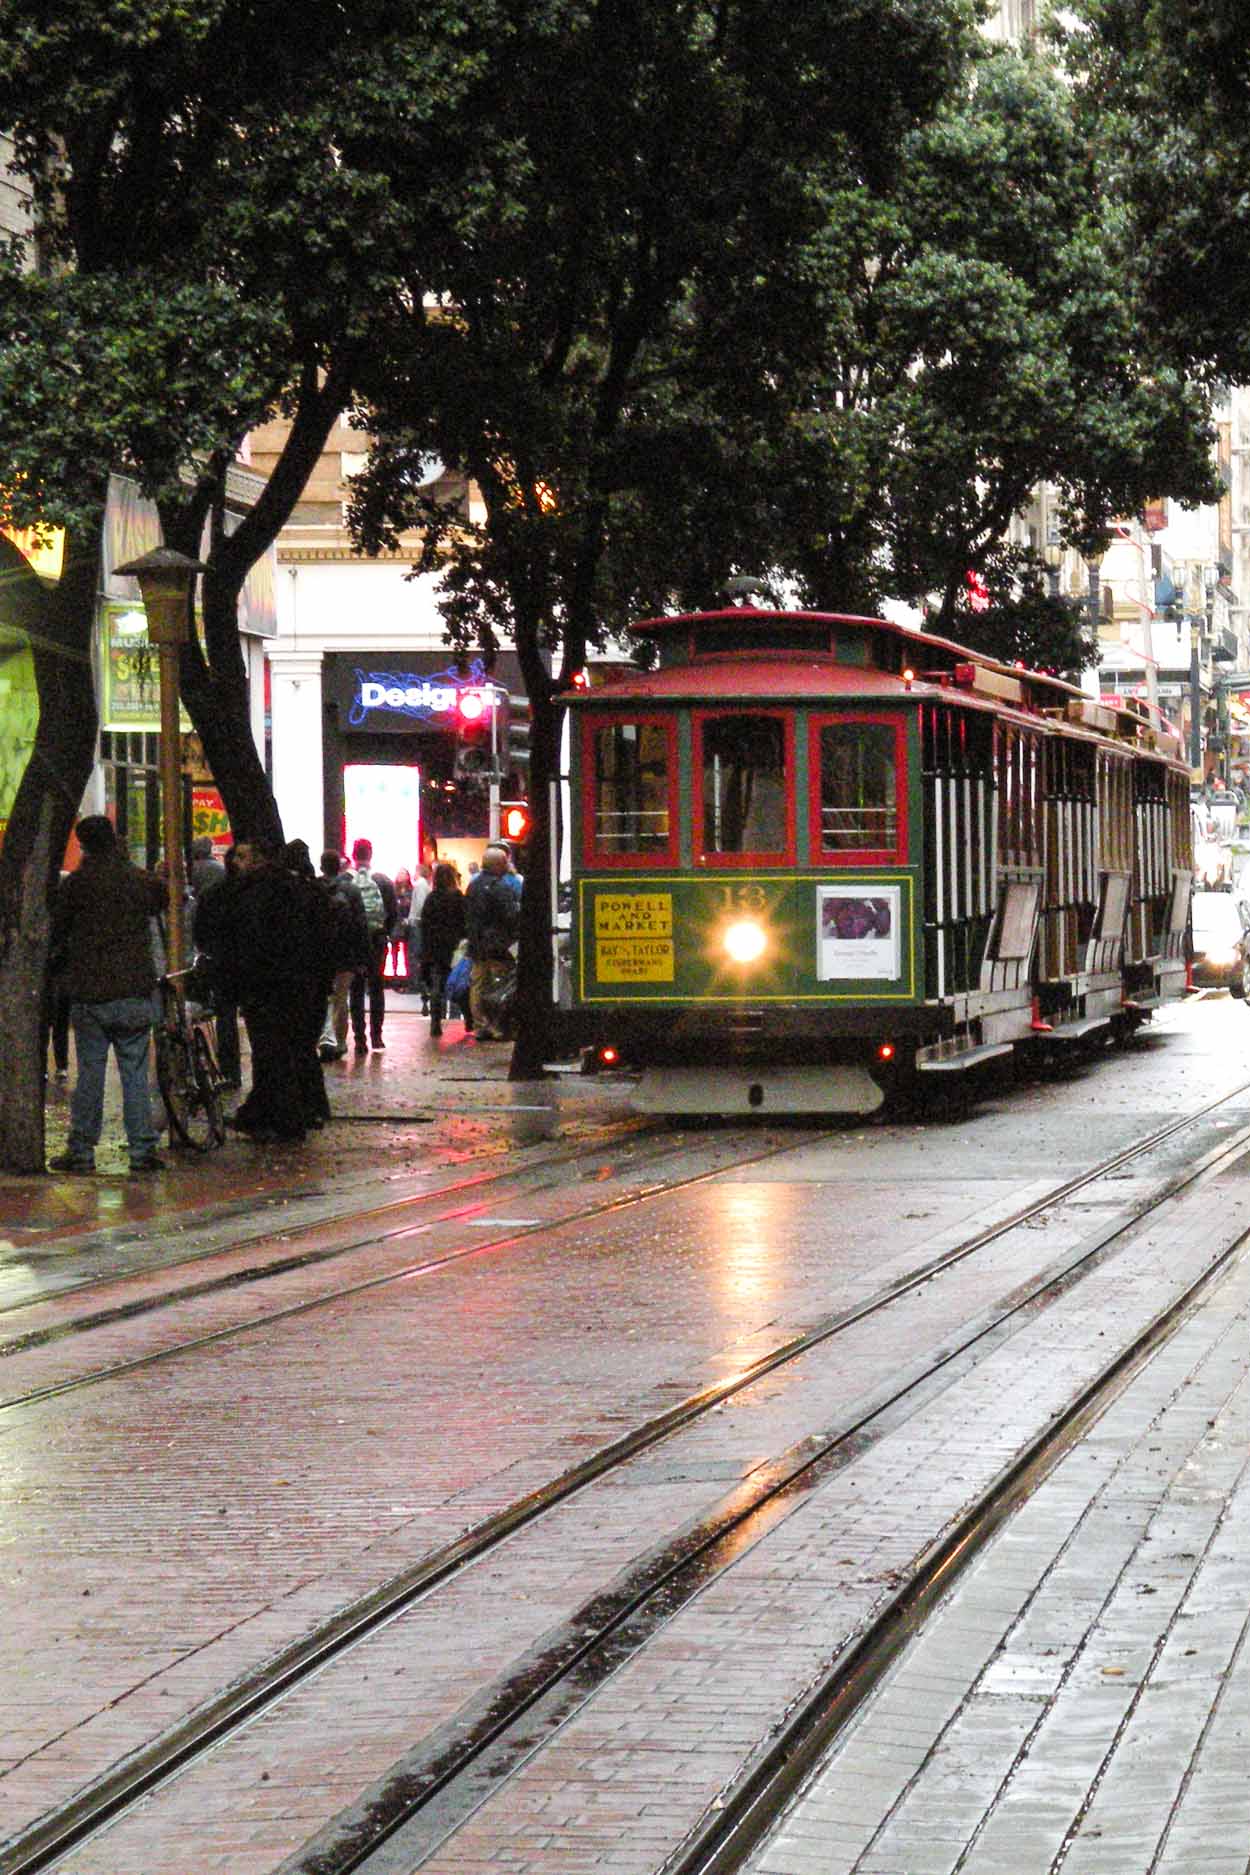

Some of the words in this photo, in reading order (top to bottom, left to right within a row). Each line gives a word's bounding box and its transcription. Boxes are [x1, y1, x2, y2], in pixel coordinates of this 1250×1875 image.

[600, 901, 668, 912] POWELL
[619, 912, 652, 921] AND
[599, 921, 668, 931] MARKET
